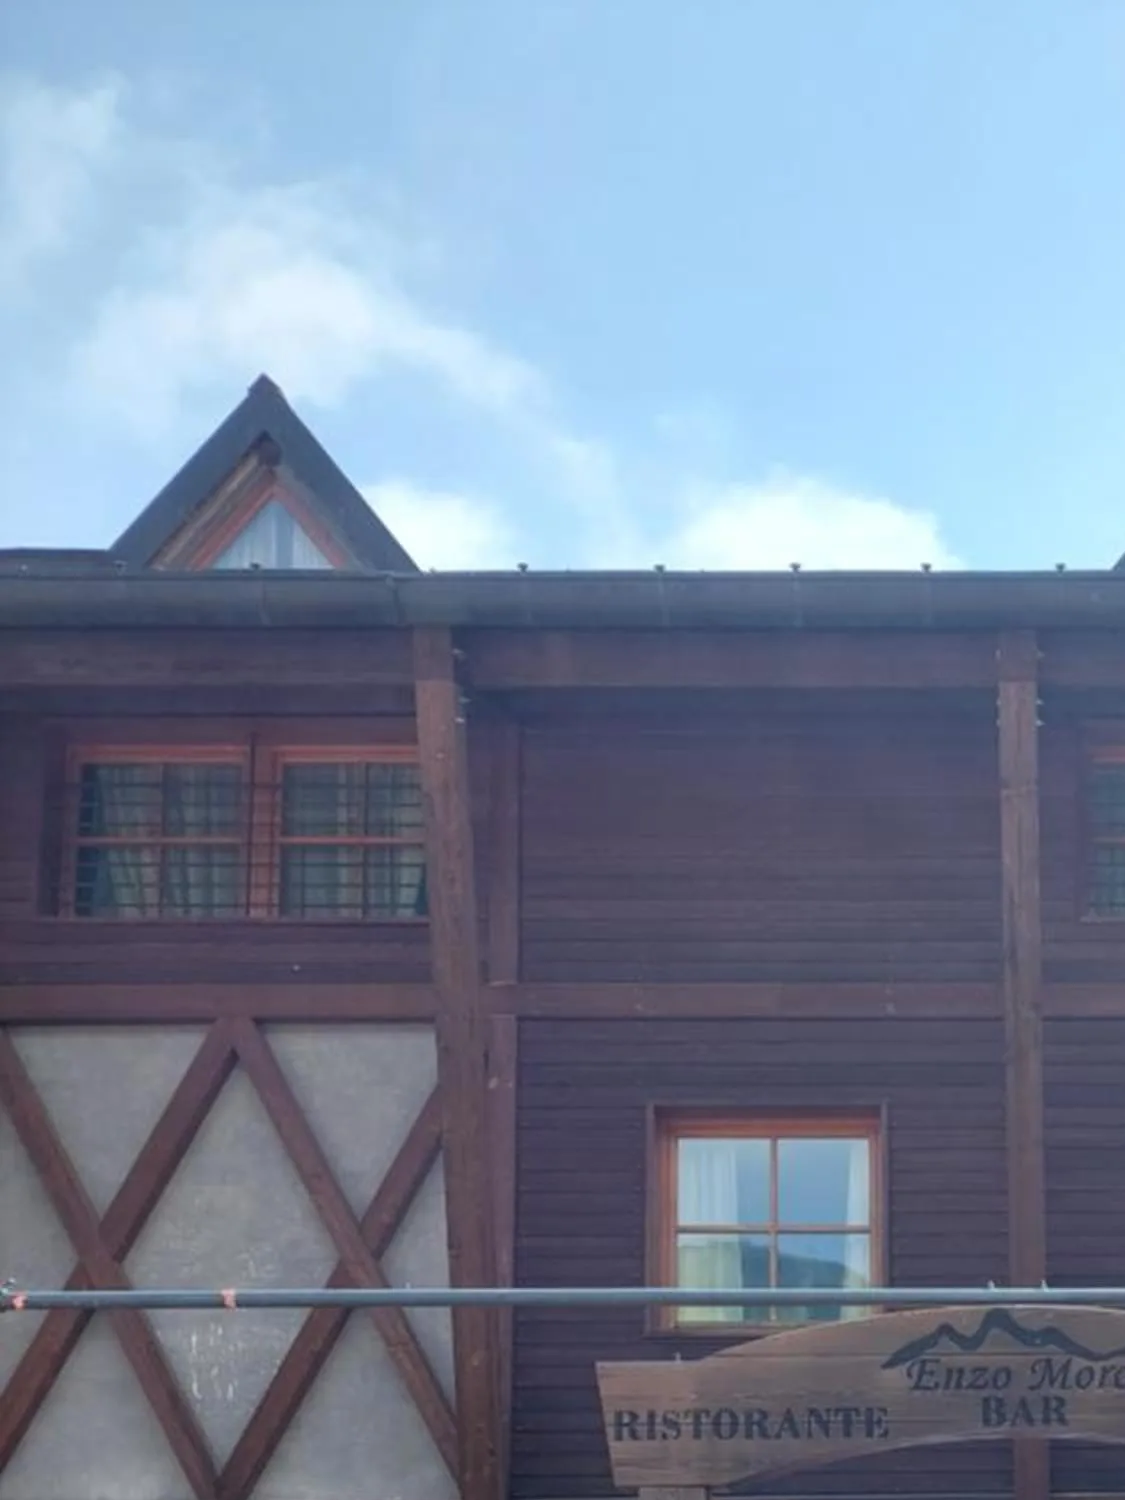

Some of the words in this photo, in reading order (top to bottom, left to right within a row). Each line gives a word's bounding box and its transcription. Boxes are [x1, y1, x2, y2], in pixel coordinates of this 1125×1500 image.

[906, 1357, 1012, 1391] Enzo
[612, 1406, 889, 1441] RISTORANTE
[980, 1395, 1070, 1428] BAR
